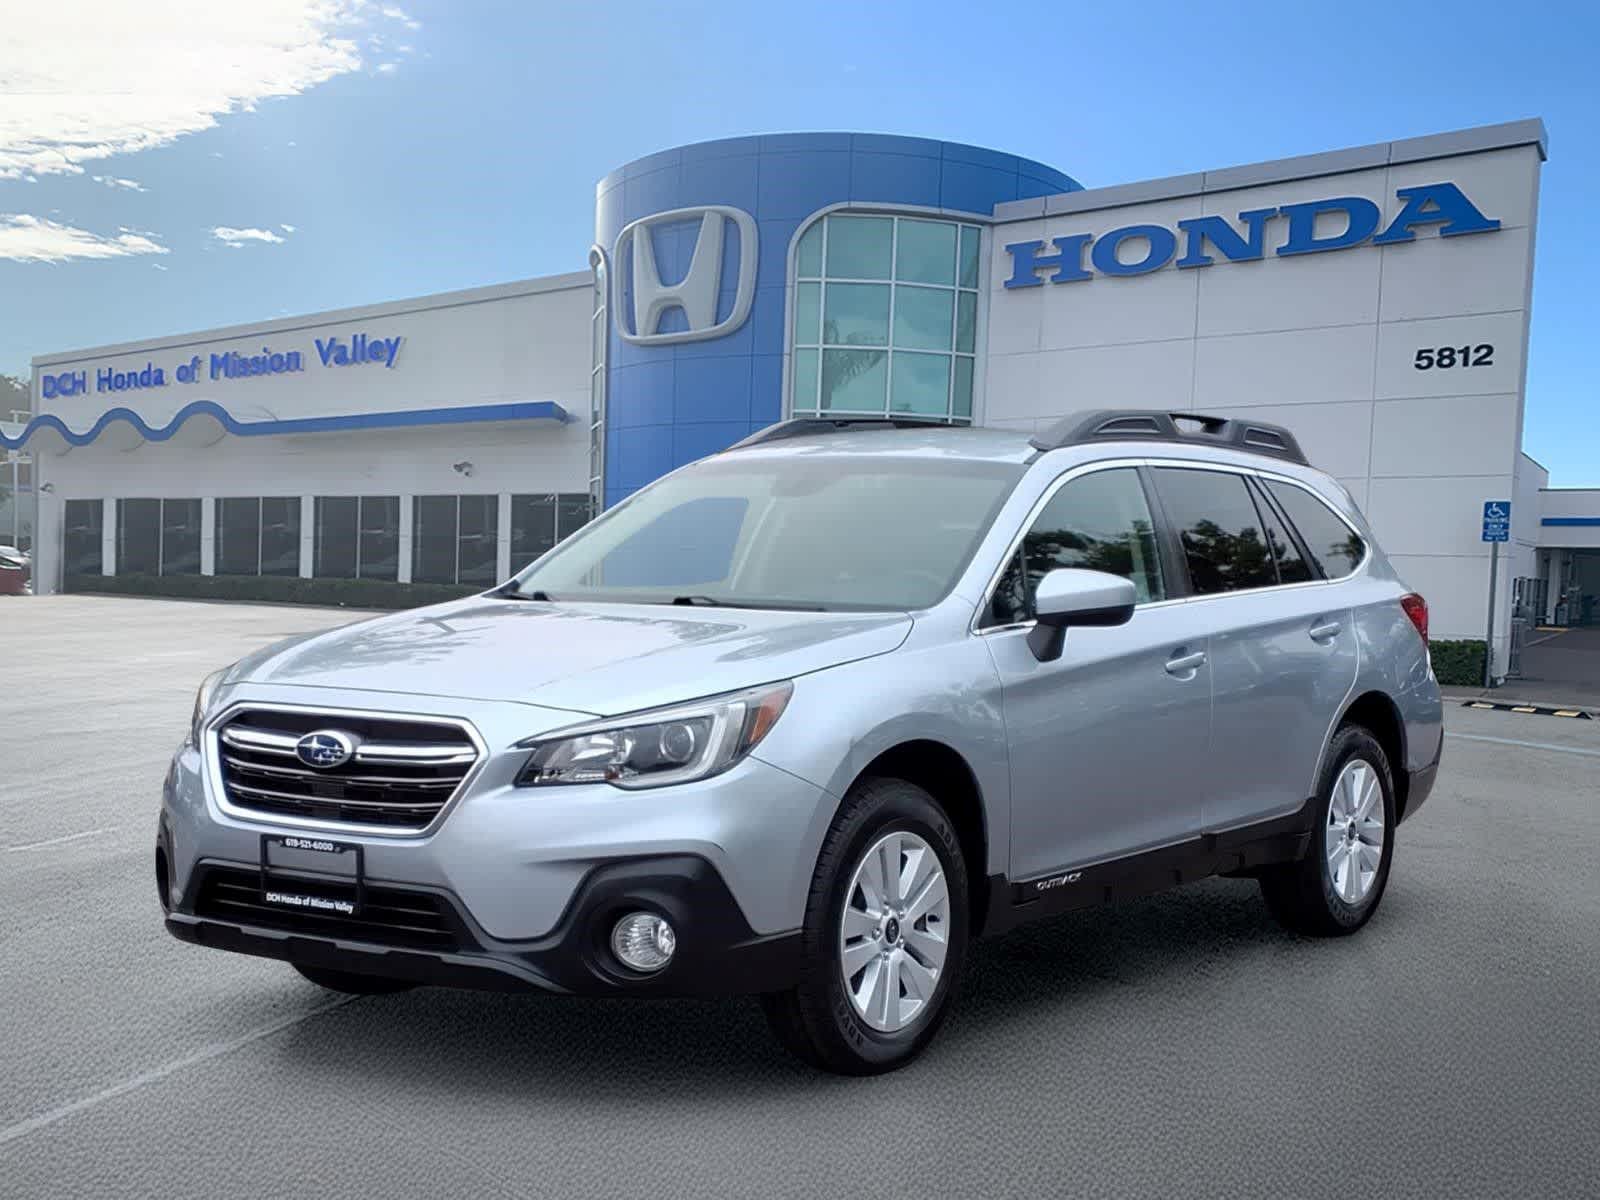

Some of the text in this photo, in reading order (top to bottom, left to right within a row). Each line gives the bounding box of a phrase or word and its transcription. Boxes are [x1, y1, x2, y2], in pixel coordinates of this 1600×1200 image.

[1003, 182, 1501, 289] HONDA
[42, 333, 402, 399] DCH Honda of Mission Valley
[1414, 344, 1494, 370] 5812
